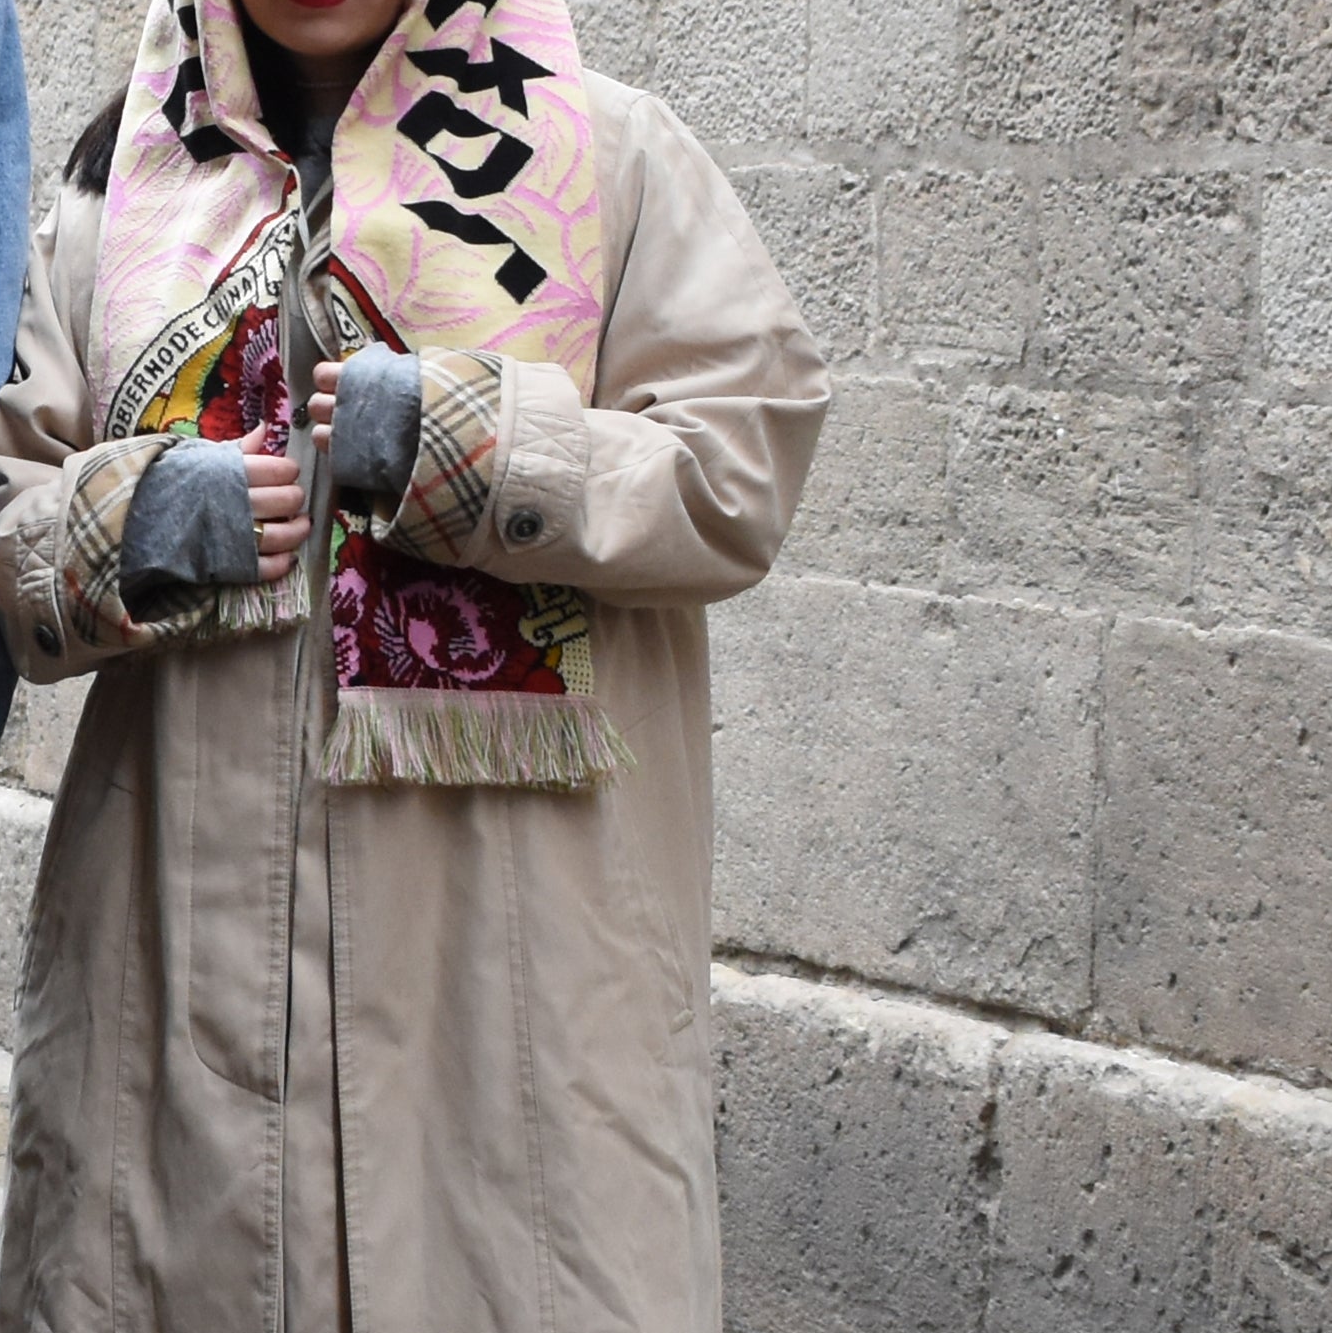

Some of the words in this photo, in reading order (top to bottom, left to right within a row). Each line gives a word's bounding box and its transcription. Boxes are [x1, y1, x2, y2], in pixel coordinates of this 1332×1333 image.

[111, 344, 175, 440] OBIERNO
[167, 320, 206, 355] DE
[202, 276, 254, 329] CHINA
